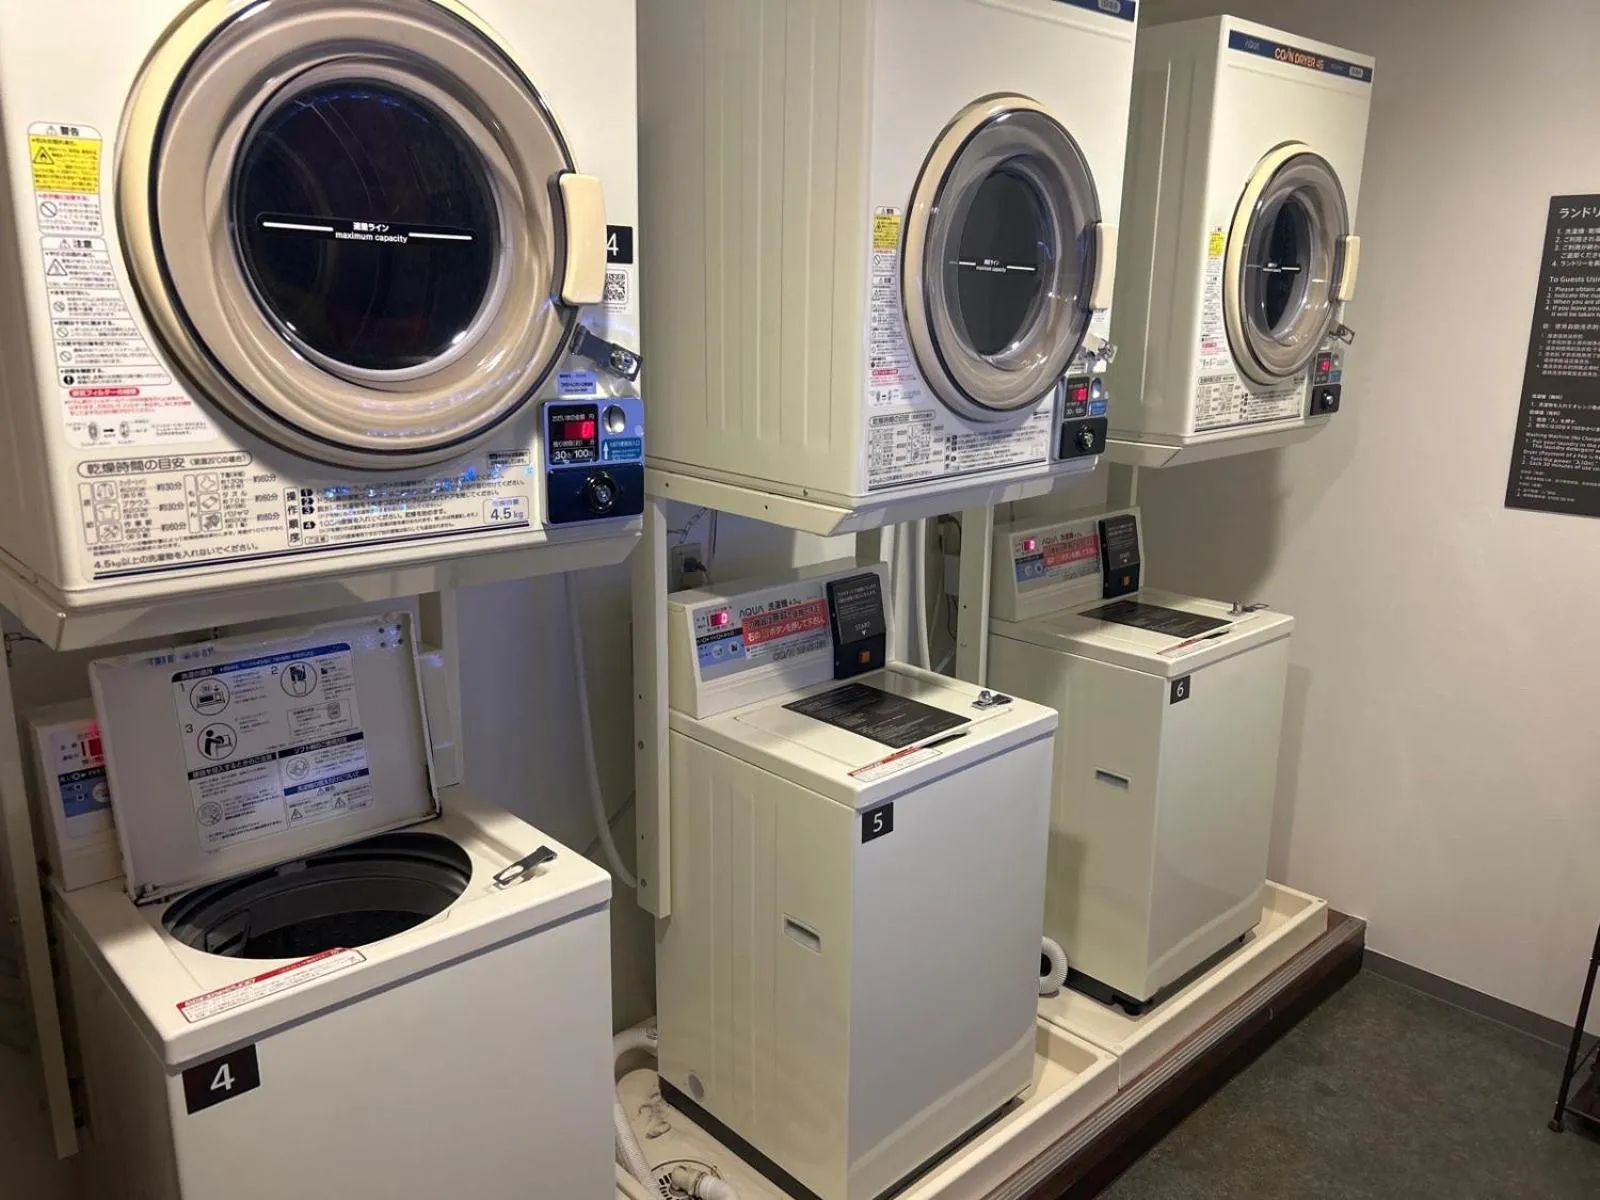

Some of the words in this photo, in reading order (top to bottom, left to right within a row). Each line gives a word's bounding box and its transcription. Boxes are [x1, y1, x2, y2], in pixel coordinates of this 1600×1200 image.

[1295, 52, 1316, 67] DRYER
[335, 231, 373, 242] maximum
[375, 233, 408, 244] capacity
[606, 232, 619, 256] 4
[582, 420, 594, 439] 0
[87, 458, 185, 475] 乾燥時間の目安
[490, 507, 512, 521] 4.5
[513, 511, 524, 521] kg
[739, 604, 765, 618] AQUA
[270, 666, 279, 675] 2
[1176, 682, 1184, 697] 6
[185, 724, 194, 734] 3
[872, 812, 883, 833] 5
[210, 1063, 236, 1091] 4
